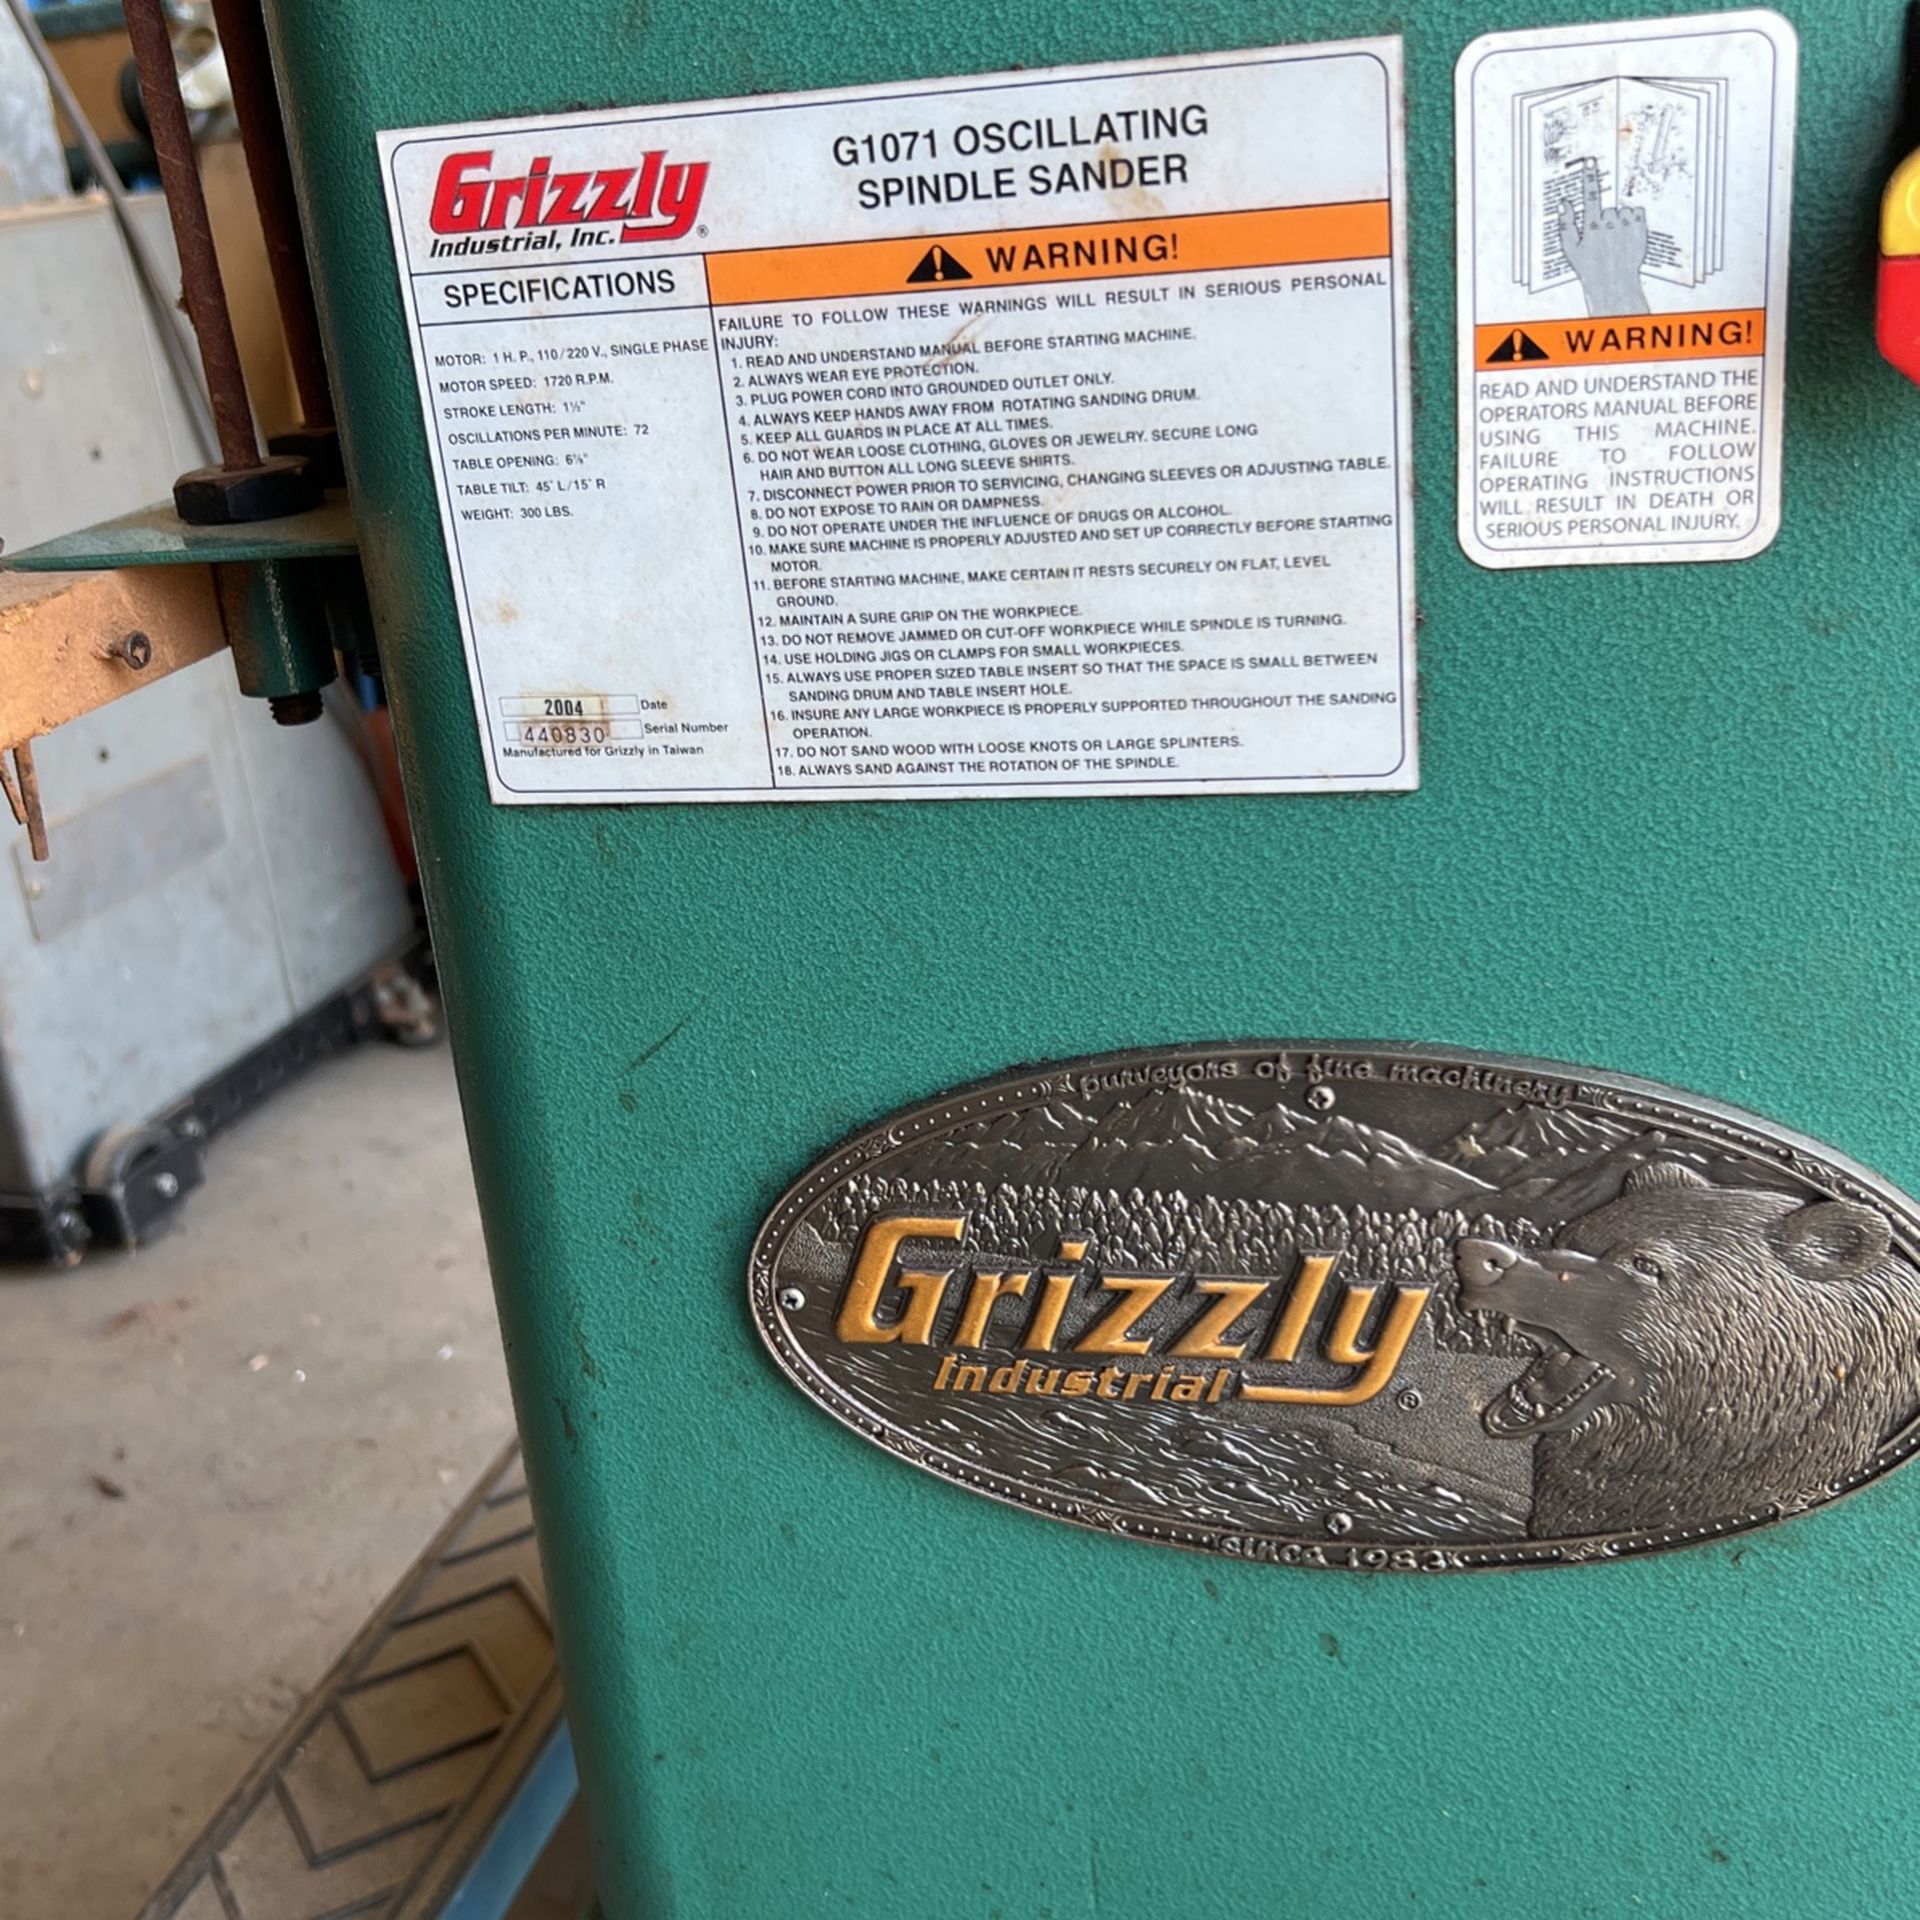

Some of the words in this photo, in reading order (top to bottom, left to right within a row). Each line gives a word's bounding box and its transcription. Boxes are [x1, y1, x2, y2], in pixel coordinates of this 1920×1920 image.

[833, 129, 936, 167] G1071
[953, 104, 1208, 156] OSCILLATING
[858, 167, 1017, 210] SPINDLE
[1029, 153, 1187, 196] SANDER
[430, 150, 711, 243] Grizzly
[430, 229, 562, 258] Industrial,
[570, 227, 615, 247] Inc.
[985, 233, 1178, 273] WARNING!
[444, 269, 675, 308] SPECIFICATIONS
[718, 314, 784, 332] FAILURE
[791, 312, 813, 327] TO
[821, 308, 888, 325] FOLLOW
[897, 303, 950, 320] THESE
[958, 296, 1047, 317] WARNINGS
[1056, 293, 1096, 308] WILL
[1105, 287, 1169, 305] RESULT
[1179, 286, 1195, 299] IN
[1205, 279, 1281, 298] SERIOUS
[1291, 272, 1386, 291] PERSONAL
[721, 334, 778, 350] INJURY:
[731, 357, 742, 369] 1.
[745, 354, 785, 369] READ
[787, 352, 817, 366] AND
[820, 346, 916, 364] UNDERSTAND
[919, 340, 980, 359] MANUAL
[984, 337, 1043, 353] BEFORE
[1047, 332, 1120, 349] STARTING
[1124, 327, 1195, 343] MACHINE.
[1565, 320, 1752, 353] WARNING!
[434, 353, 486, 367] MOTOR:
[493, 352, 499, 363] 1
[610, 342, 660, 357] SINGLE
[662, 338, 709, 353] PHASE
[439, 379, 487, 393] MOTOR
[489, 376, 537, 391] SPEED:
[544, 374, 573, 387] 1720
[575, 372, 614, 385] R.P.M.
[733, 376, 745, 388] 2.
[748, 372, 804, 387] ALWAYS
[806, 369, 849, 383] WEAR
[852, 367, 880, 381] EYE
[883, 360, 979, 379] PROTECTION.
[1480, 382, 1530, 400] READ
[1535, 378, 1578, 397] AND
[1584, 371, 1716, 394] UNDERSTAND
[1720, 369, 1757, 387] THE
[736, 395, 747, 407] 3.
[750, 391, 788, 406] PLUG
[791, 389, 843, 403] POWER
[846, 386, 887, 401] CORD
[890, 383, 924, 398] INTO
[926, 379, 1009, 396] GROUNDED
[1012, 374, 1069, 391] OUTLET
[1073, 372, 1114, 387] ONLY.
[443, 405, 497, 420] STROKE
[499, 402, 556, 416] LENGTH:
[1479, 402, 1588, 424] OPERATORS
[1594, 398, 1678, 417] MANUAL
[1684, 393, 1757, 414] BEFORE
[448, 429, 541, 445] OSCILLATIONS
[543, 427, 571, 440] PER
[573, 425, 627, 438] MINUTE:
[634, 424, 649, 435] 72
[1480, 428, 1541, 448] USING
[1574, 424, 1619, 442] THIS
[1655, 417, 1756, 438] MACHINE.
[452, 457, 494, 470] TABLE
[496, 454, 559, 469] OPENING:
[1480, 451, 1558, 470] FAILURE
[1599, 447, 1627, 464] TO
[1669, 441, 1756, 461] FOLLOW
[456, 483, 498, 496] TABLE
[500, 481, 529, 494] TILT:
[595, 478, 606, 489] R
[1479, 472, 1588, 494] OPERATING
[1610, 465, 1755, 487] INSTRUCTIONS
[460, 508, 513, 521] WEIGHT:
[520, 507, 542, 519] 300
[544, 505, 573, 518] LBS.
[750, 509, 762, 520] 8.
[765, 507, 785, 520] DO
[788, 505, 816, 518] NOT
[820, 503, 875, 517] EXPOSE
[878, 502, 898, 514] TO
[900, 500, 934, 513] RAIN
[937, 499, 958, 512] OR
[961, 495, 1044, 510] DAMPNESS.
[1479, 499, 1523, 516] WILL
[1536, 495, 1605, 514] RESULT
[1616, 494, 1636, 510] IN
[1649, 491, 1714, 509] DEATH
[1726, 488, 1754, 506] OR
[1486, 520, 1563, 539] SERIOUS
[1567, 516, 1666, 535] PERSONAL
[758, 616, 776, 627] 12.
[779, 613, 844, 626] MAINTAIN
[847, 613, 857, 624] A
[859, 611, 897, 624] SURE
[900, 610, 934, 623] GRIP
[937, 609, 958, 622] ON
[961, 608, 989, 620] THE
[992, 604, 1082, 619] WORKPIECE.
[544, 699, 583, 716] 2004
[640, 699, 668, 710] Date
[525, 725, 605, 744] 440830
[644, 723, 678, 734] Serial
[681, 722, 728, 733] Number
[503, 746, 582, 757] Manufactured
[584, 746, 601, 756] for
[604, 746, 644, 757] Grizzly
[662, 745, 703, 755] Taiwan
[775, 747, 793, 758] 17.
[796, 746, 817, 758] DO
[819, 745, 848, 757] NOT
[851, 744, 889, 757] SAND
[892, 743, 936, 756] WOOD
[939, 742, 974, 754] WITH
[977, 741, 1025, 754] LOOSE
[1029, 740, 1078, 752] KNOTS
[1081, 739, 1102, 752] OR
[1106, 738, 1155, 751] LARGE
[1160, 736, 1242, 749] SPLINTERS.
[778, 765, 795, 776] 18.
[798, 764, 852, 776] ALWAYS
[854, 763, 893, 775] SAND
[896, 761, 955, 774] AGAINST
[958, 761, 986, 773] THE
[989, 759, 1058, 772] ROTATION
[1061, 758, 1080, 771] OF
[1083, 758, 1112, 769] THE
[1115, 757, 1179, 769] SPINDLE.
[1254, 1052, 1291, 1083] of
[834, 1215, 1433, 1405] Grizzly
